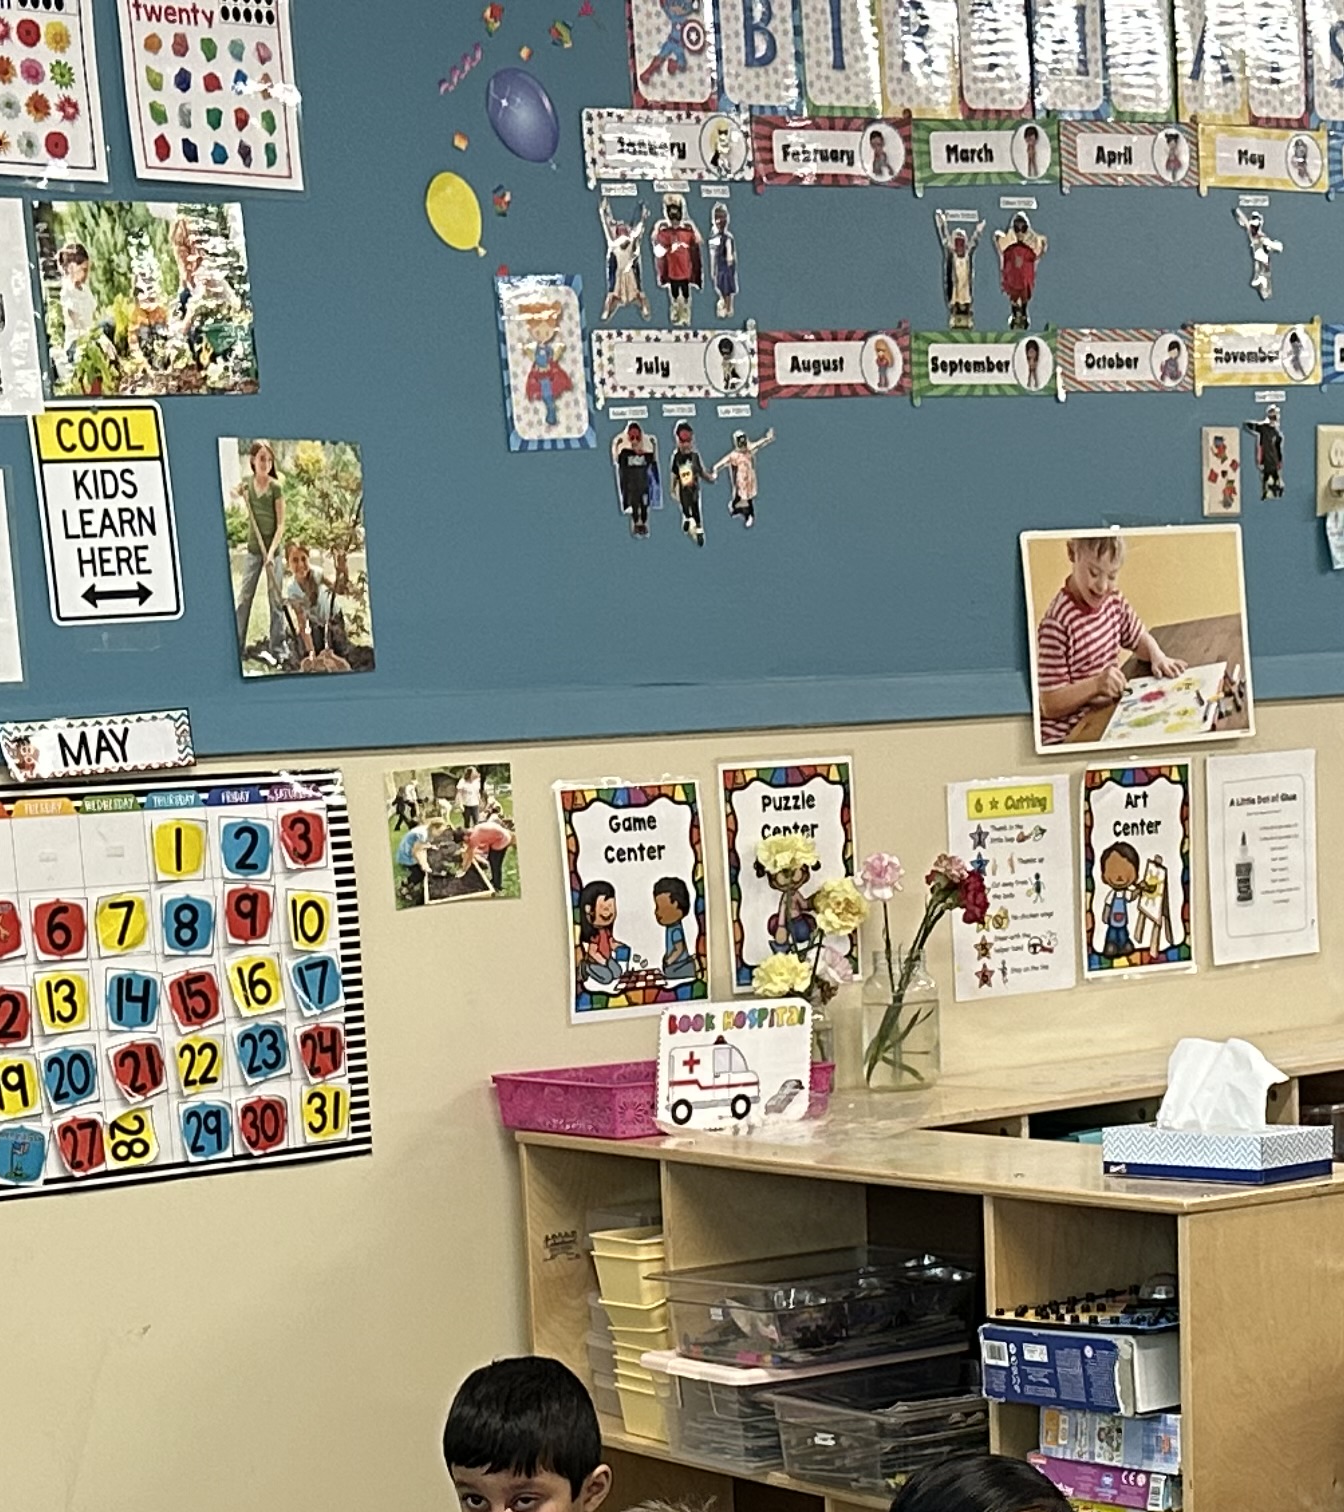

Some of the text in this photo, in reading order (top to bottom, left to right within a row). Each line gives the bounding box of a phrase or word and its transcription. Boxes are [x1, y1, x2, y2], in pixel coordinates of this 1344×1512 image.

[131, 1, 214, 28] twenty
[945, 143, 995, 164] March
[1095, 145, 1133, 168] April
[1237, 149, 1265, 172] May
[634, 354, 671, 379] July
[790, 354, 845, 376] August
[930, 354, 1011, 377] September
[1084, 350, 1139, 371] October
[55, 417, 145, 454] COOL
[72, 469, 140, 500] KIDS
[62, 507, 158, 540] LEARN
[77, 547, 152, 579] HERE
[58, 728, 130, 768] MAY
[221, 790, 250, 805] FRIDAY
[761, 792, 816, 814] Puzzle
[974, 794, 1048, 813] 6 Cutting
[1125, 790, 1149, 809] Art
[608, 813, 657, 833] Game
[761, 820, 819, 841] Center
[1113, 817, 1162, 838] Center
[173, 817, 313, 873] 1 2 3
[604, 842, 666, 864] Center
[46, 906, 73, 952] 6
[108, 900, 137, 947] 7
[172, 902, 200, 947] 8
[233, 892, 258, 938] 9
[291, 899, 325, 945] 10
[45, 978, 79, 1025] 13
[116, 975, 153, 1023] 14
[176, 974, 212, 1020] 15
[235, 962, 273, 1007] 16
[298, 960, 331, 1006] 17
[667, 1013, 716, 1037] BOOK
[45, 1051, 92, 1097] 20
[118, 1049, 157, 1094] 21
[178, 1041, 219, 1086] 22
[239, 1027, 282, 1073] 23
[299, 1027, 339, 1073] 24
[61, 1125, 100, 1170] 27
[109, 1114, 149, 1160] 28
[185, 1110, 223, 1158] 29
[241, 1102, 280, 1147] 30
[306, 1089, 343, 1134] 31
